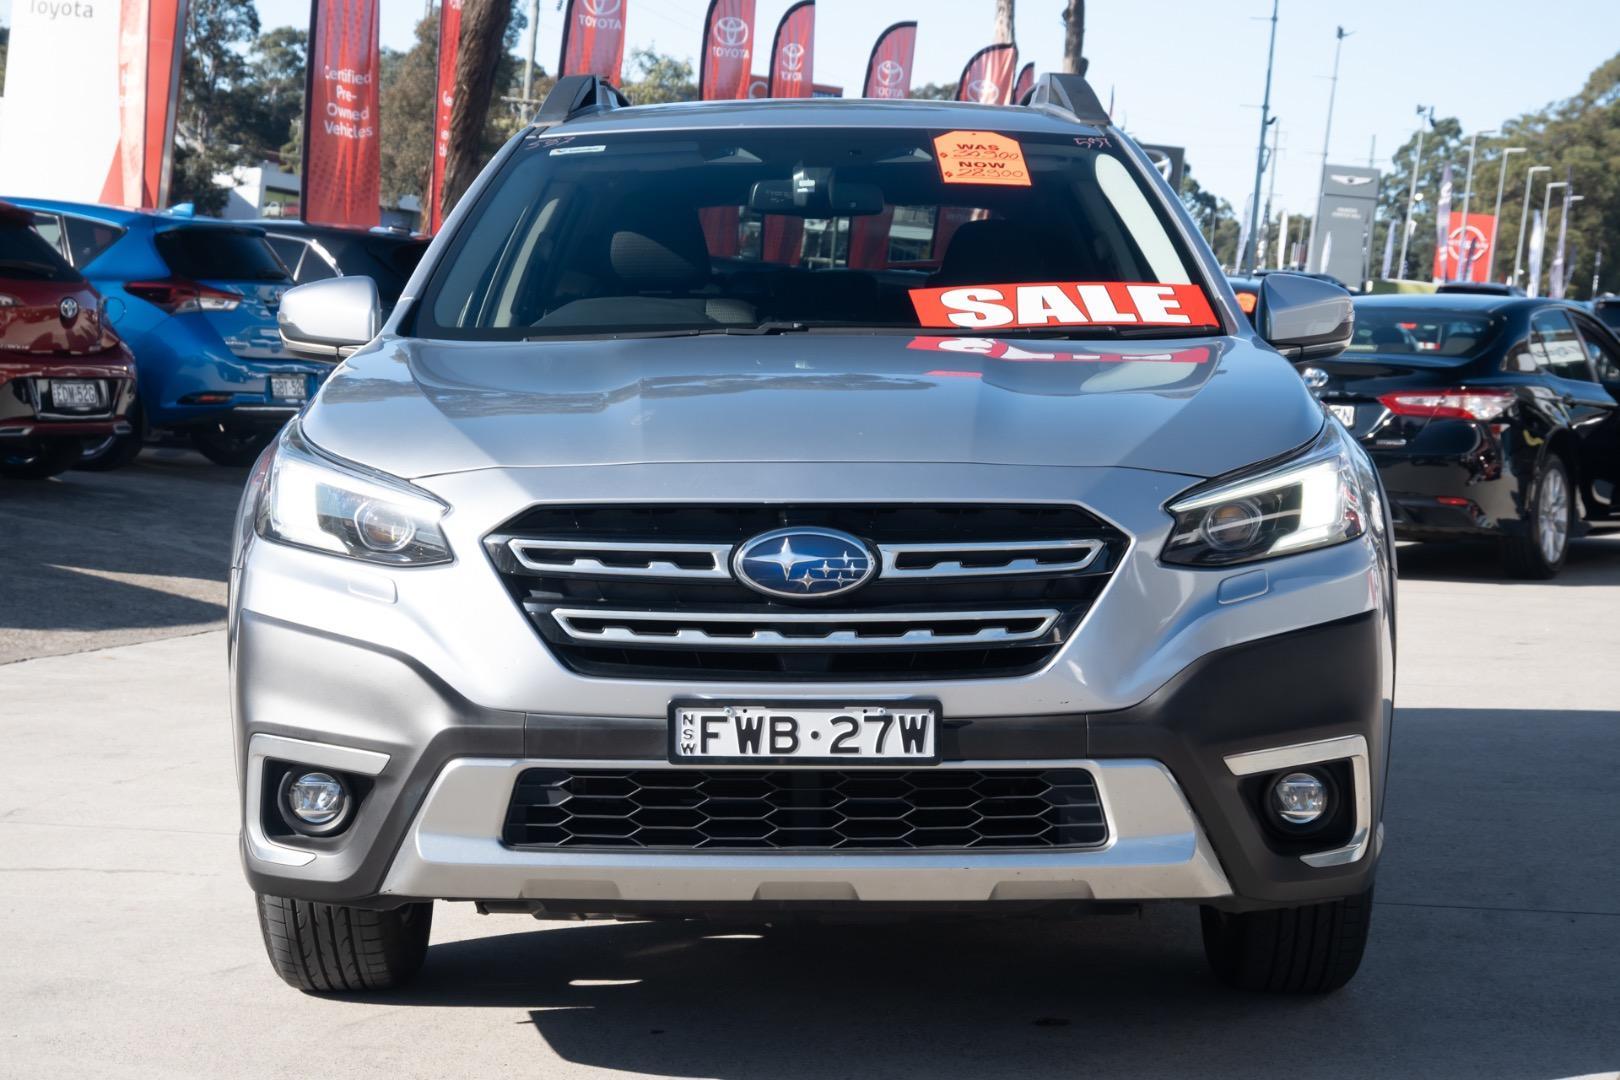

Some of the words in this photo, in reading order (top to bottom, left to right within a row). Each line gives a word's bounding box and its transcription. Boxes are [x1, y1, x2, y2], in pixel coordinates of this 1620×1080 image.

[579, 14, 621, 30] TOYOTA
[713, 46, 750, 58] TOYOTA
[324, 65, 372, 85] Certified
[327, 102, 369, 120] Owned
[324, 120, 373, 138] Vehicles
[940, 285, 1191, 327] SALE
[681, 713, 697, 755] NSW
